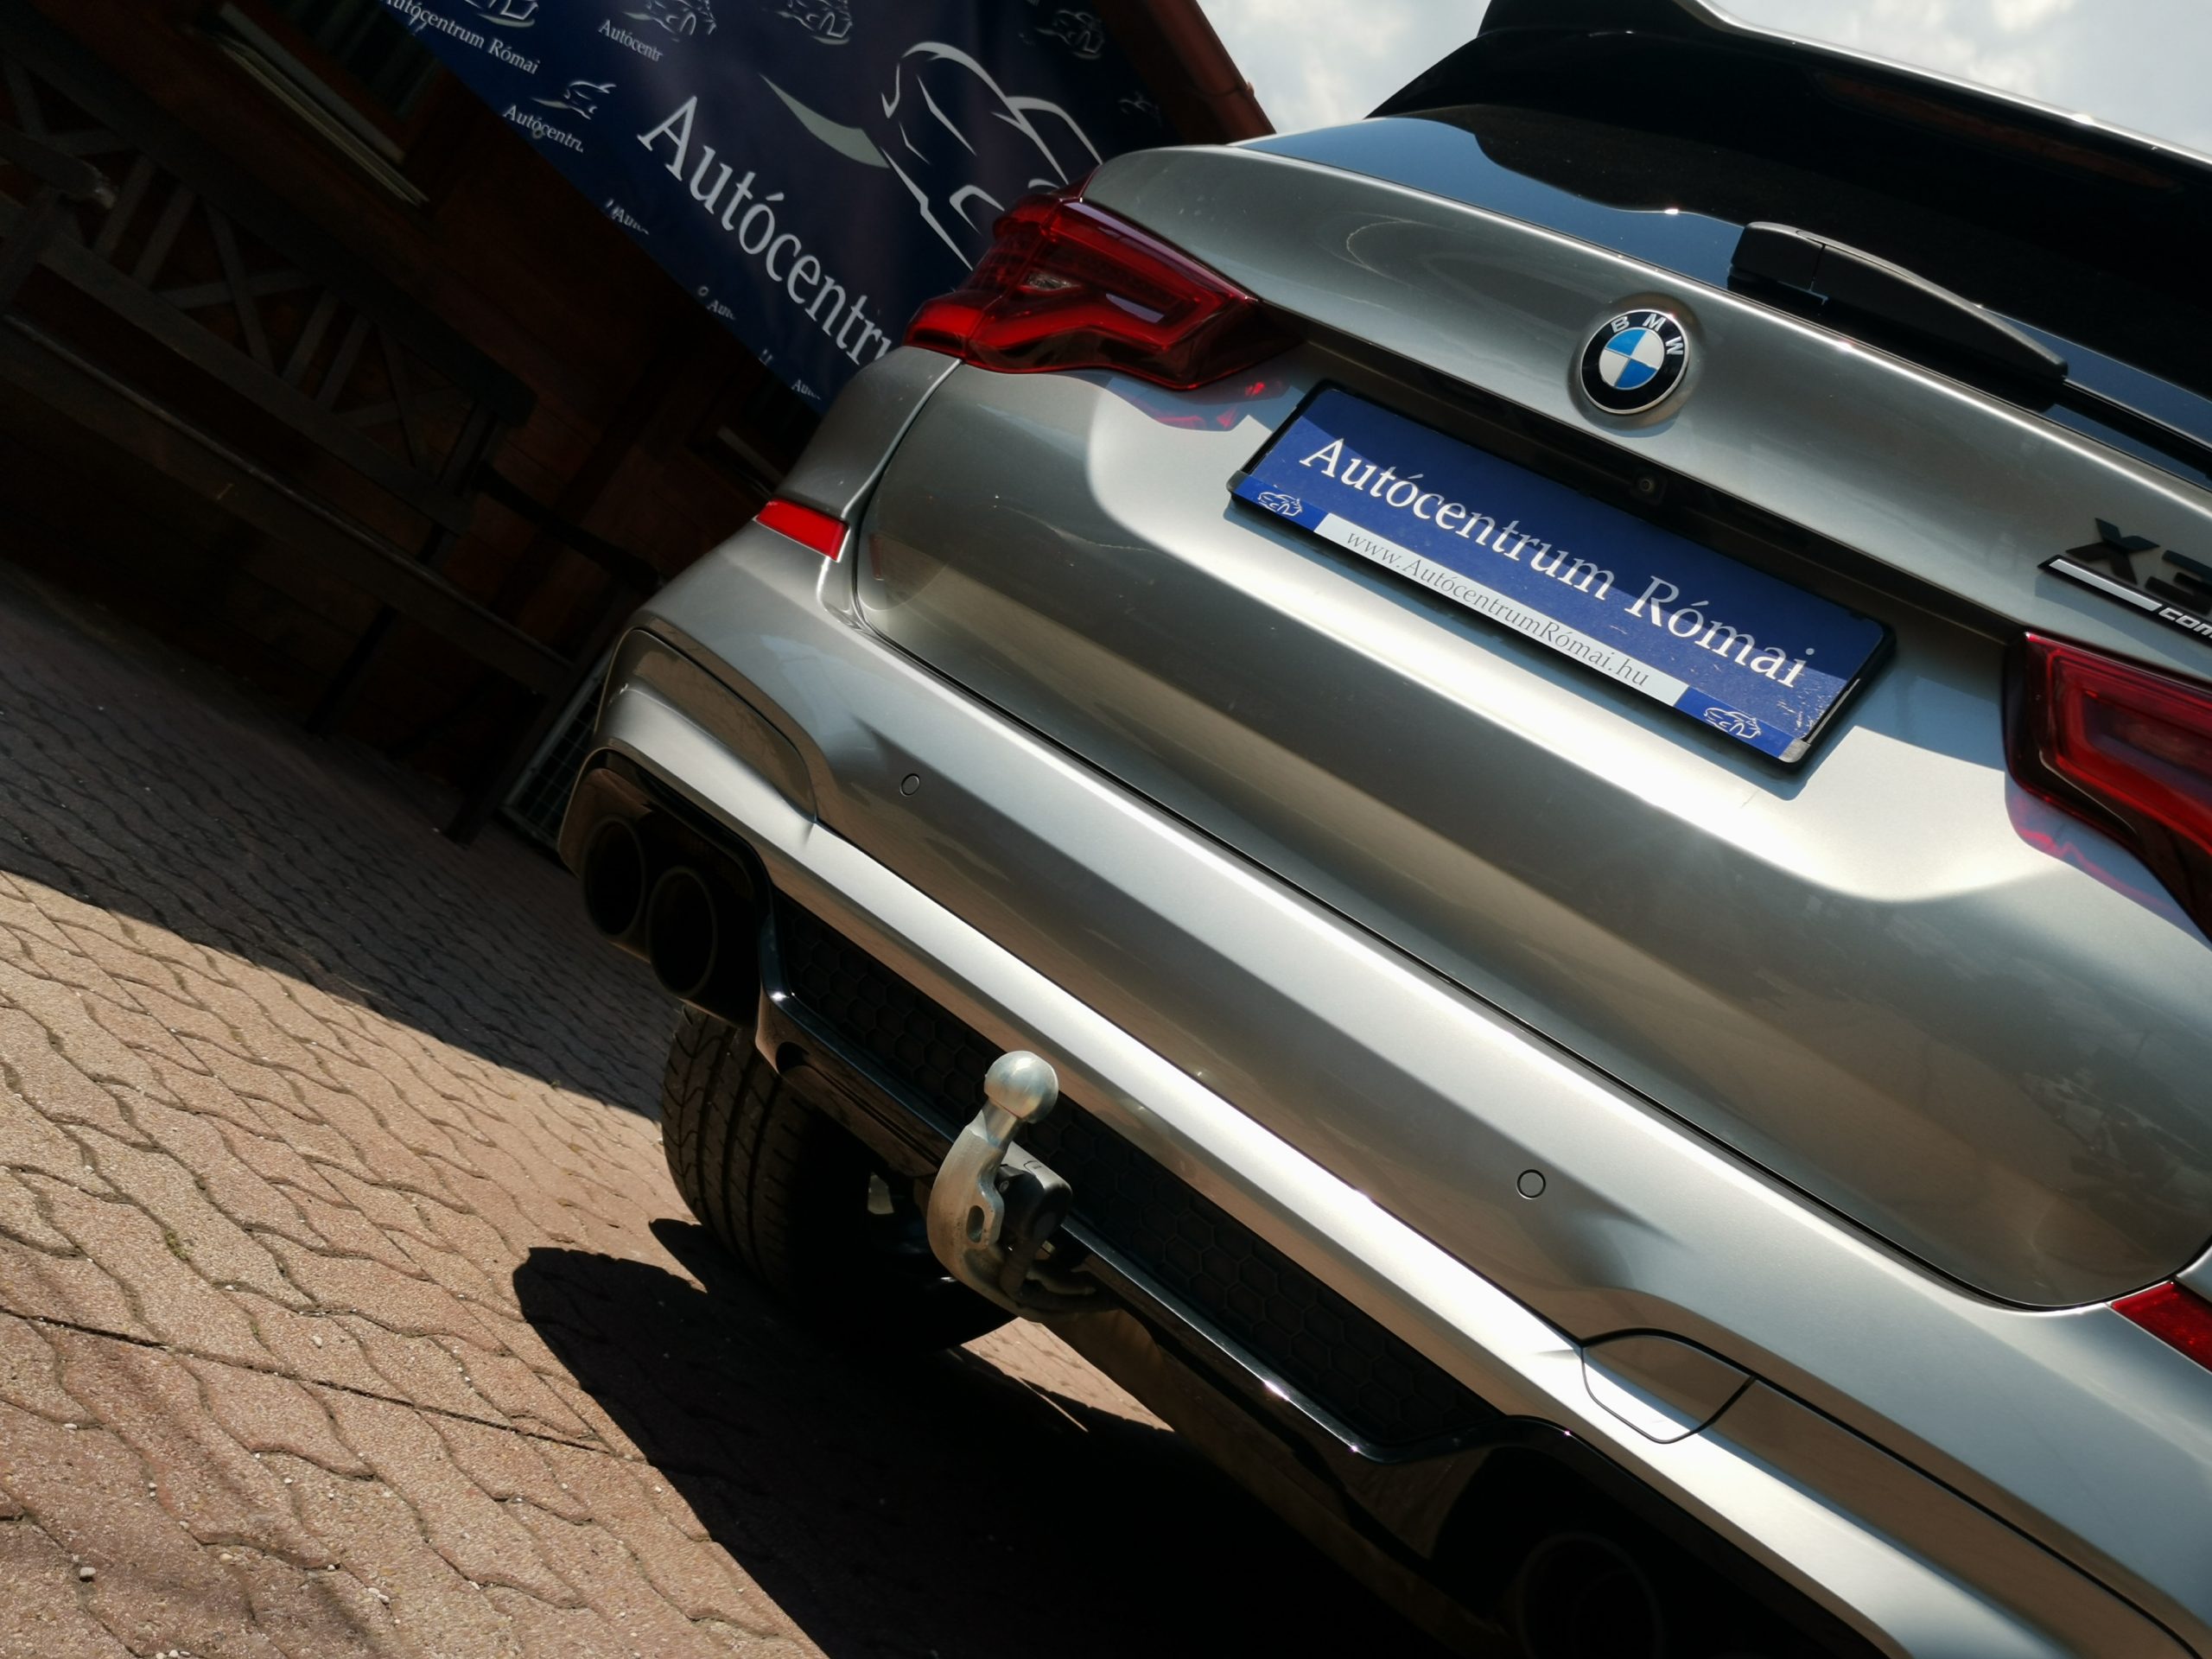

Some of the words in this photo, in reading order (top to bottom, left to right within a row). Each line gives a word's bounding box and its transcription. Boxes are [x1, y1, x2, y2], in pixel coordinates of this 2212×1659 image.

[382, 0, 485, 49] utócentrum
[487, 37, 541, 75] Római
[1611, 314, 1684, 355] BMW
[1299, 437, 1615, 601] Autócentrum
[1624, 575, 1815, 689] Római
[1346, 531, 1650, 688] www.AutócentrumRómai.hu
[2065, 517, 2212, 616] X3
